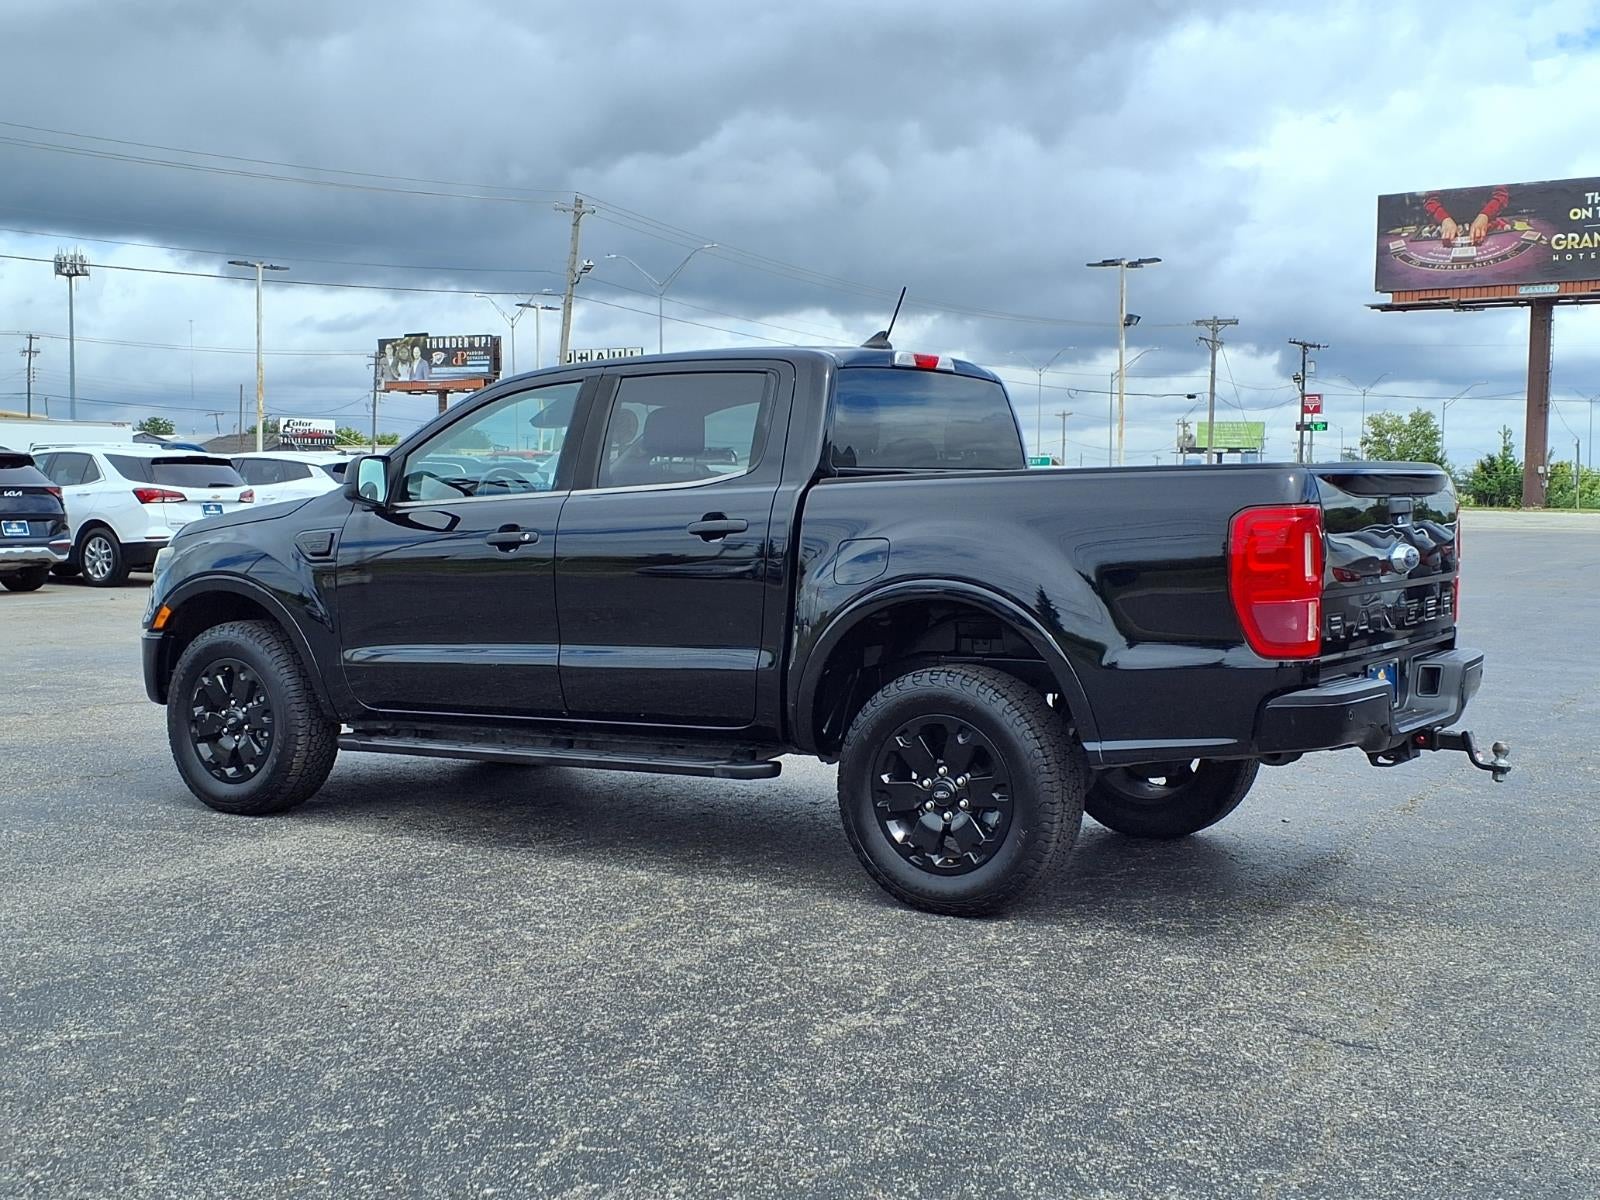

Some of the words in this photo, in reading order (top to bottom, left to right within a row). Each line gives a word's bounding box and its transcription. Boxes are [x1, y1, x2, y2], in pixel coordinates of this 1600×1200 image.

[1569, 207, 1593, 220] ON
[426, 337, 469, 349] THUNDER
[474, 336, 491, 348] UP!
[283, 419, 313, 428] Color
[1326, 592, 1452, 641] RANGER
